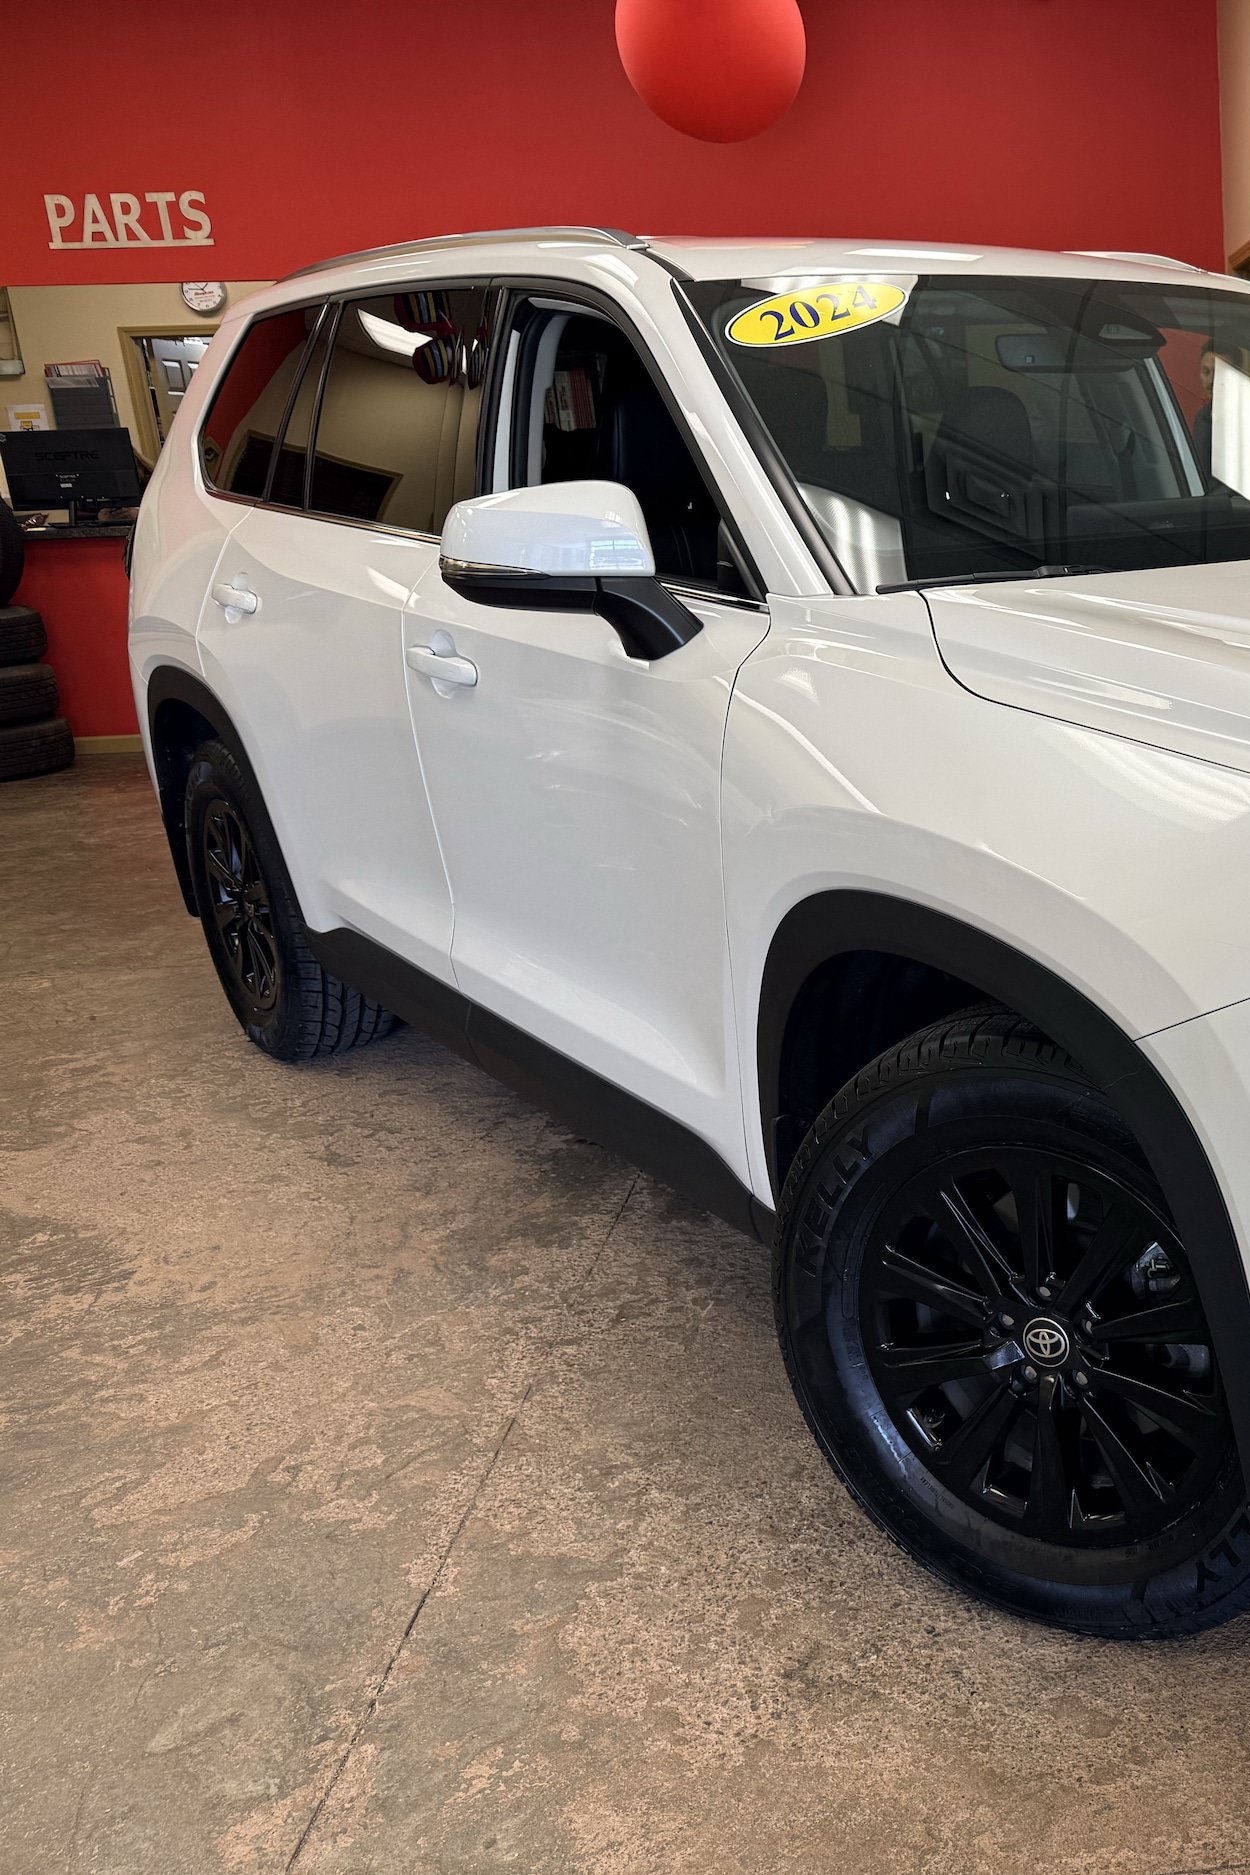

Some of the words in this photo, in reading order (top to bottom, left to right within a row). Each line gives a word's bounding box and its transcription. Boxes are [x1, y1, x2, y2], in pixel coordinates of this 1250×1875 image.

[43, 190, 213, 244] PARTS
[759, 284, 878, 341] 2024
[34, 450, 99, 461] SCEPTRE
